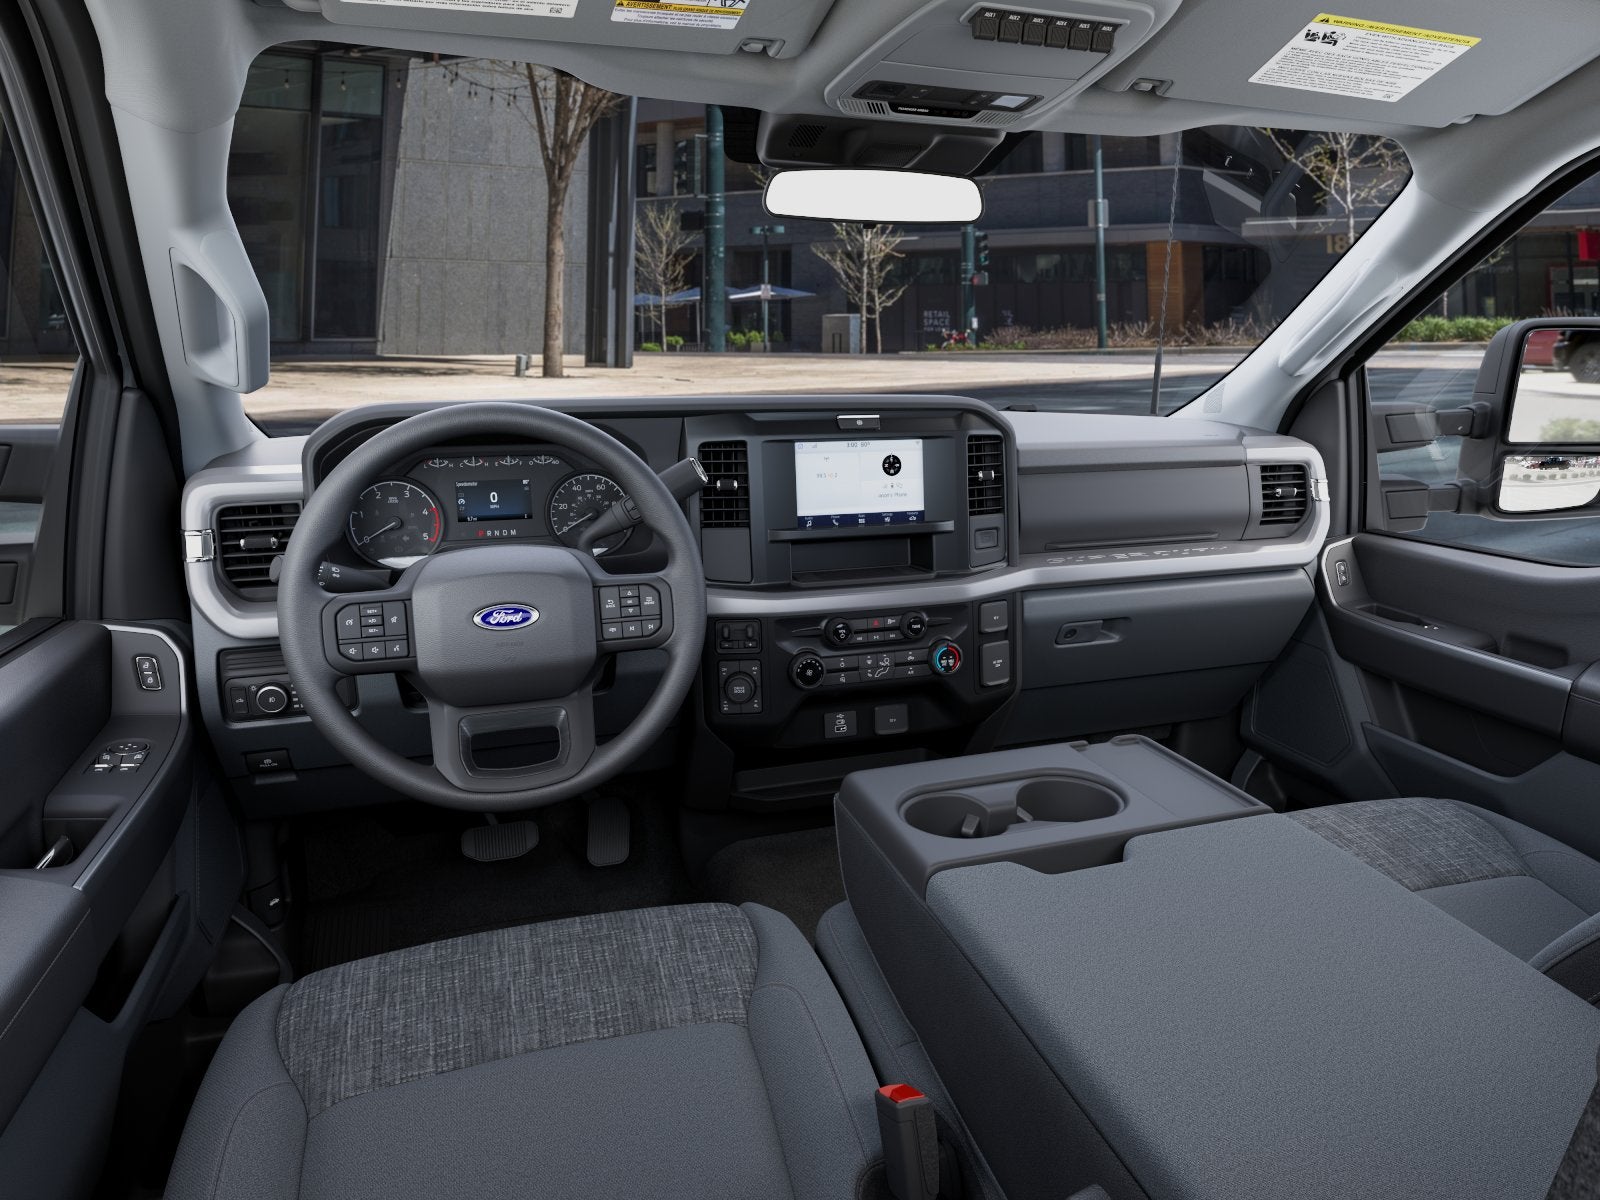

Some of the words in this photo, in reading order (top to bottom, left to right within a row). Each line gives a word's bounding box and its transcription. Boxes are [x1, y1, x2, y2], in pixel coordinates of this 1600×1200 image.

[923, 310, 951, 318] RETAIL
[923, 318, 951, 326] SPACE
[596, 483, 606, 491] 60
[375, 491, 382, 499] 2
[403, 490, 410, 498] 3
[489, 491, 498, 503] 0
[422, 508, 429, 516] 4
[422, 532, 429, 540] 5
[489, 609, 523, 624] Ford
